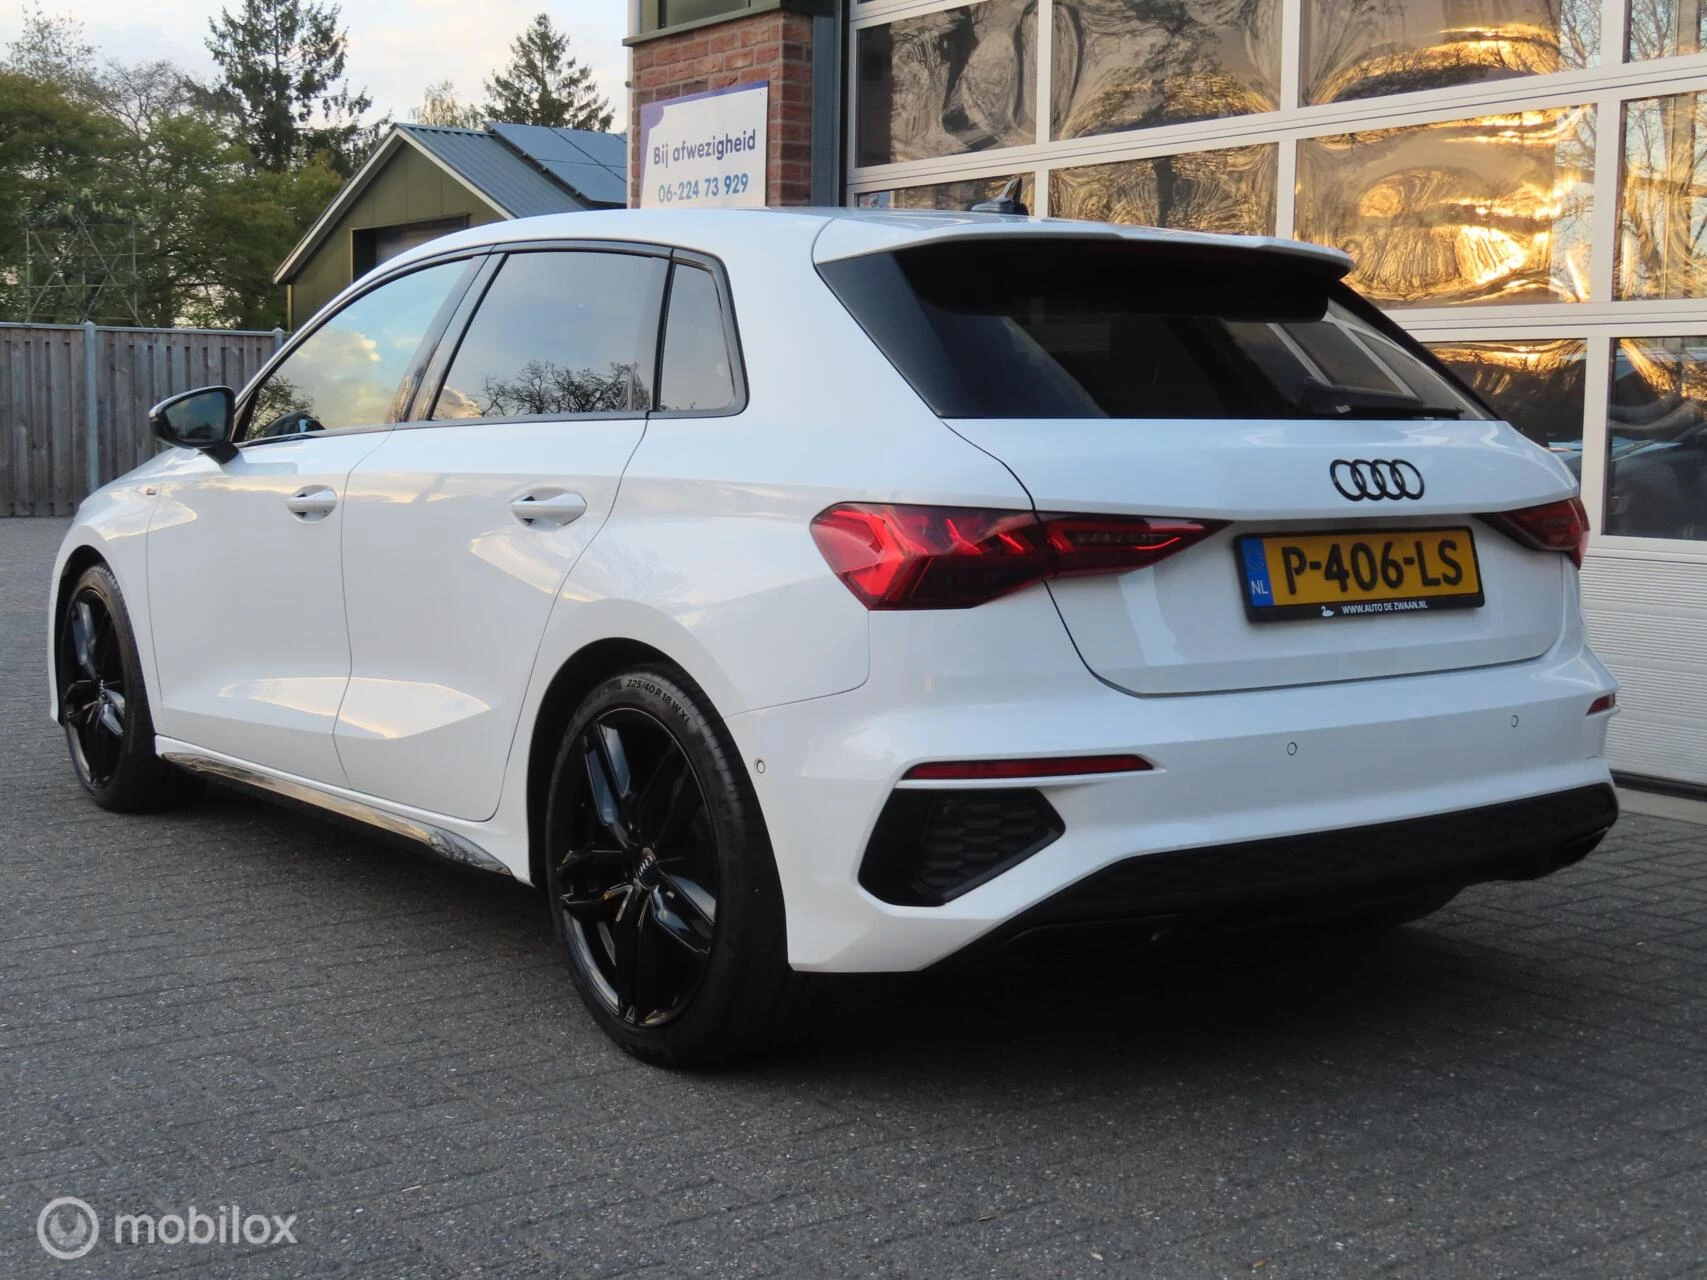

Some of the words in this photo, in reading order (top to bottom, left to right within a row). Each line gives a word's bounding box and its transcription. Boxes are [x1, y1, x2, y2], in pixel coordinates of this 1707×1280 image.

[653, 143, 669, 168] Bij
[672, 129, 756, 162] afwezigheid
[658, 180, 700, 203] 06-224
[704, 178, 719, 197] 73
[724, 173, 749, 195] 929
[1281, 539, 1463, 595] P-406-LS
[1251, 579, 1269, 595] NL
[1341, 603, 1382, 614] WWW.AUTO
[1384, 602, 1393, 611] DE
[1394, 600, 1428, 611] ZWAAN.NL
[626, 679, 655, 694] 225/40
